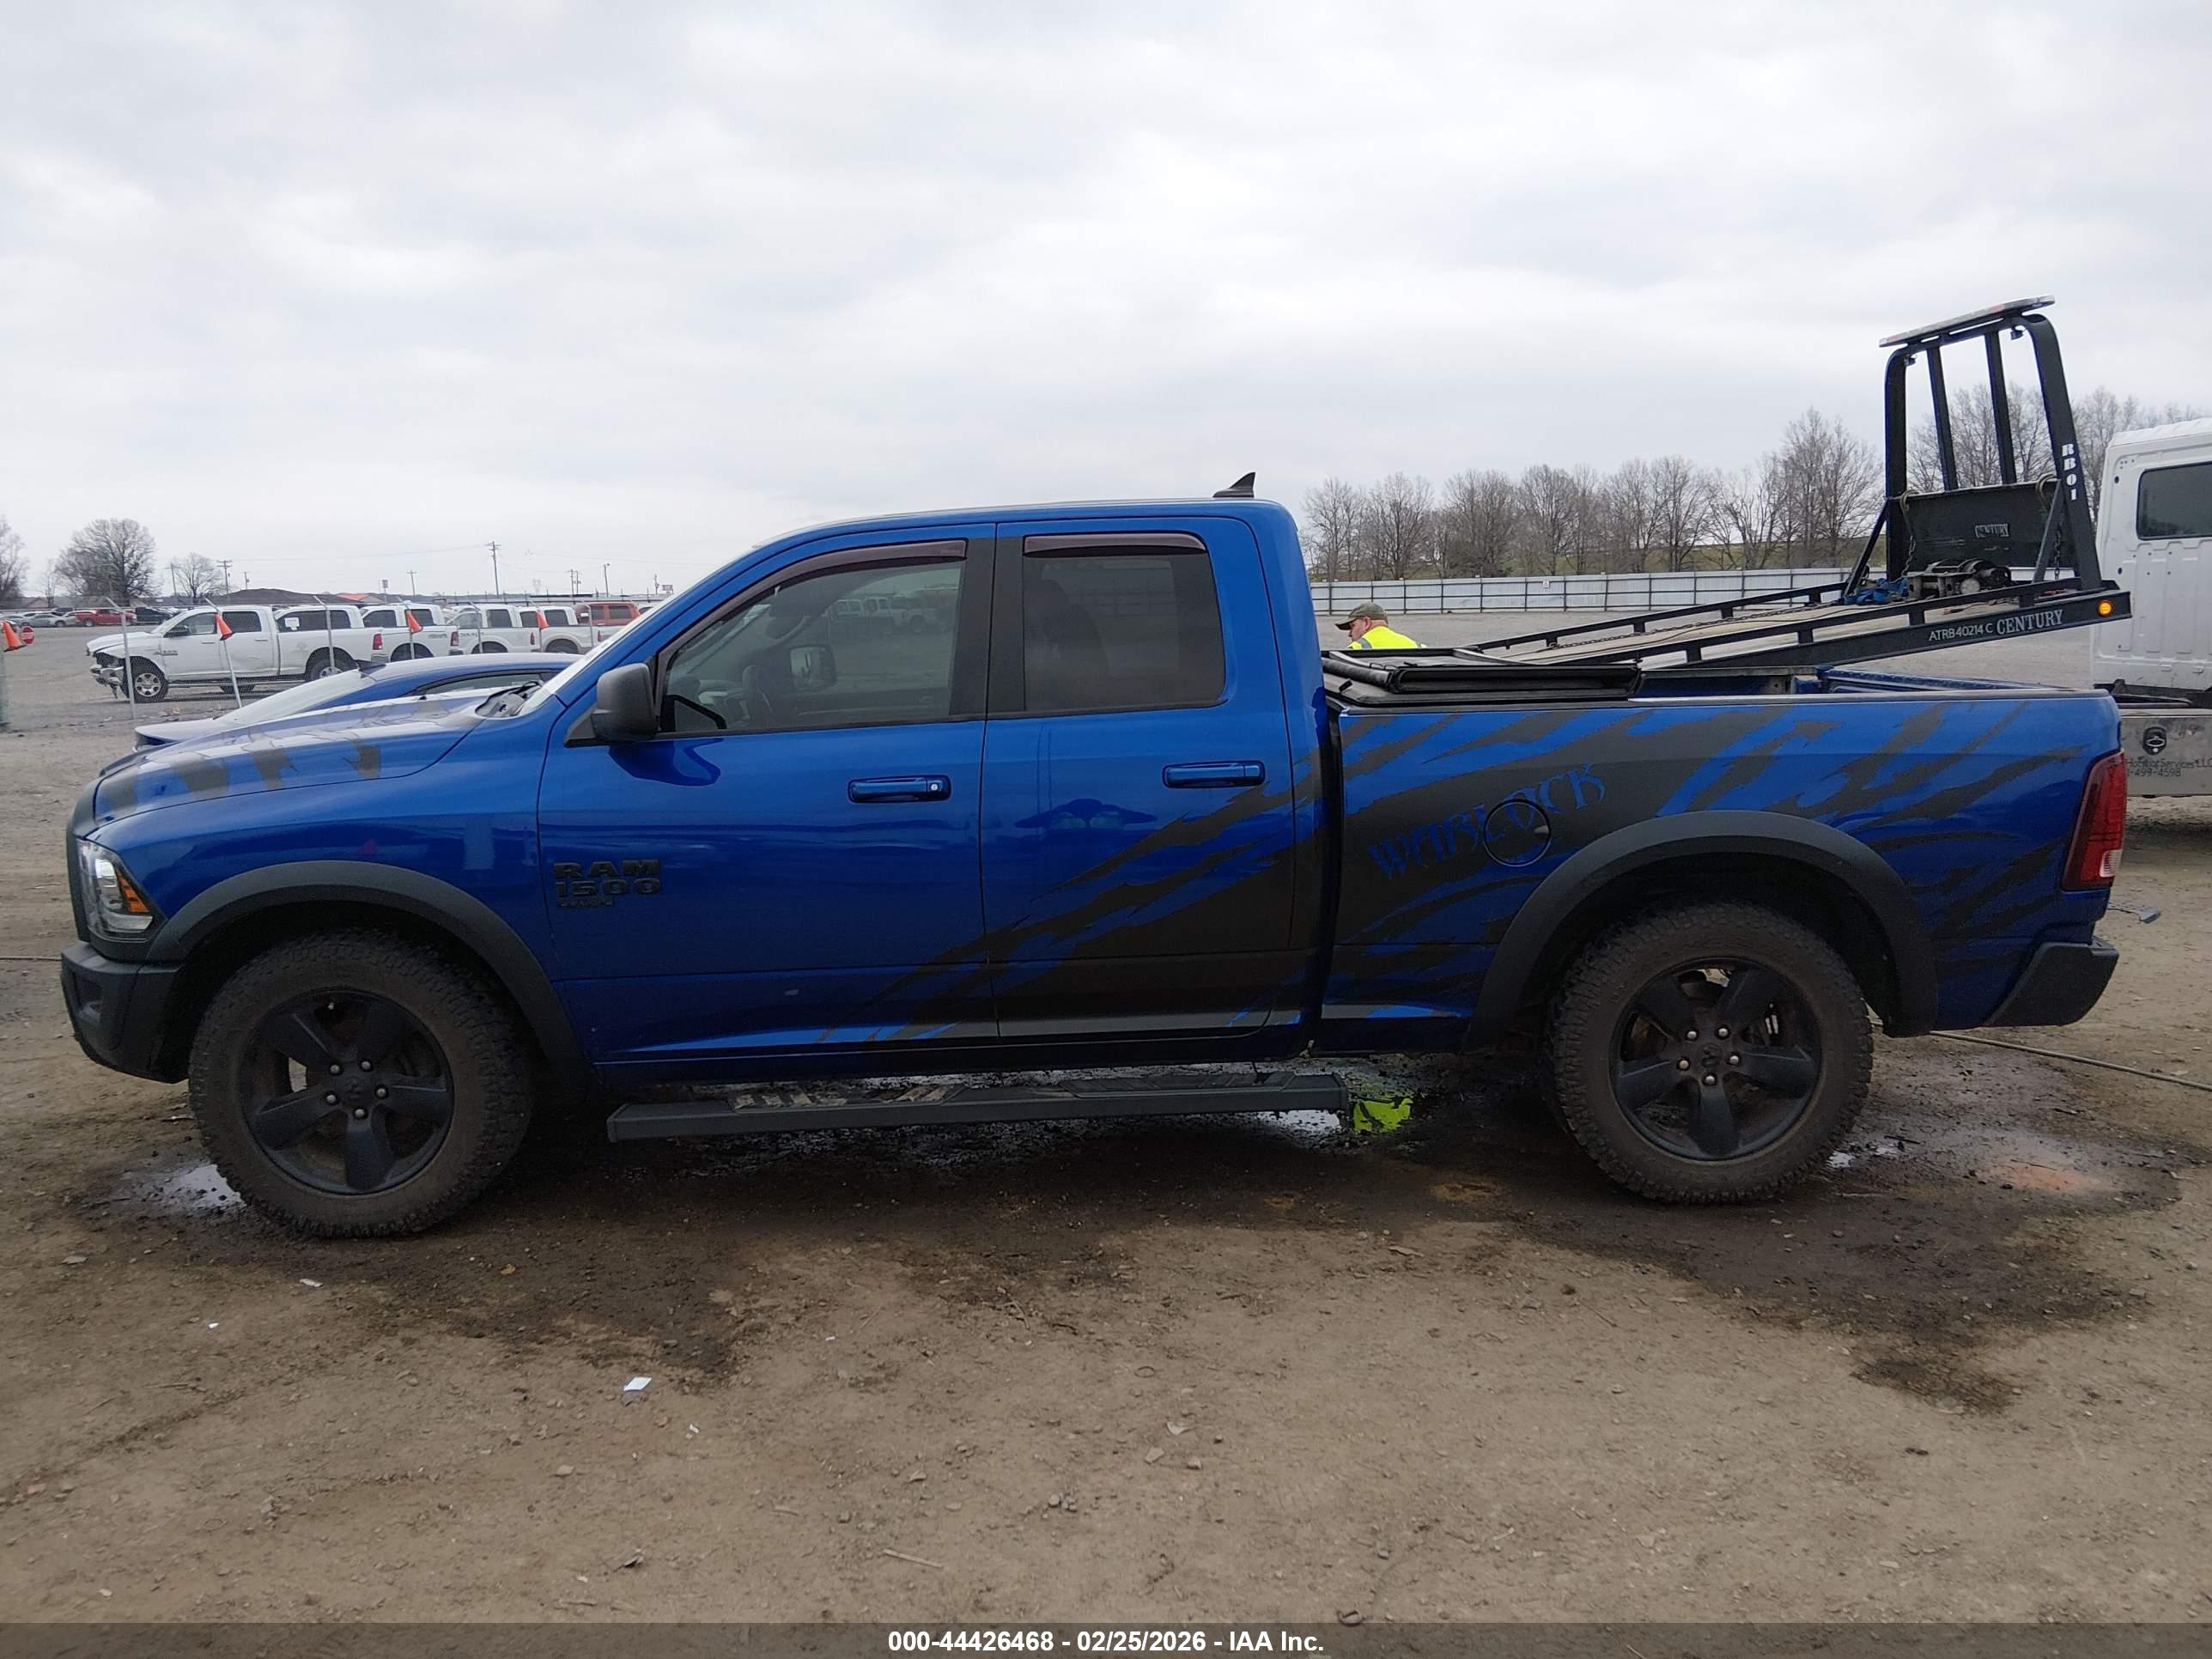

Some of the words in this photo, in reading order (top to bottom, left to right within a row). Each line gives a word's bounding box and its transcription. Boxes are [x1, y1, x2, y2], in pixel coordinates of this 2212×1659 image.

[1996, 609, 2063, 635] CENTURY
[554, 860, 659, 878] RAM
[556, 878, 660, 897] 1500
